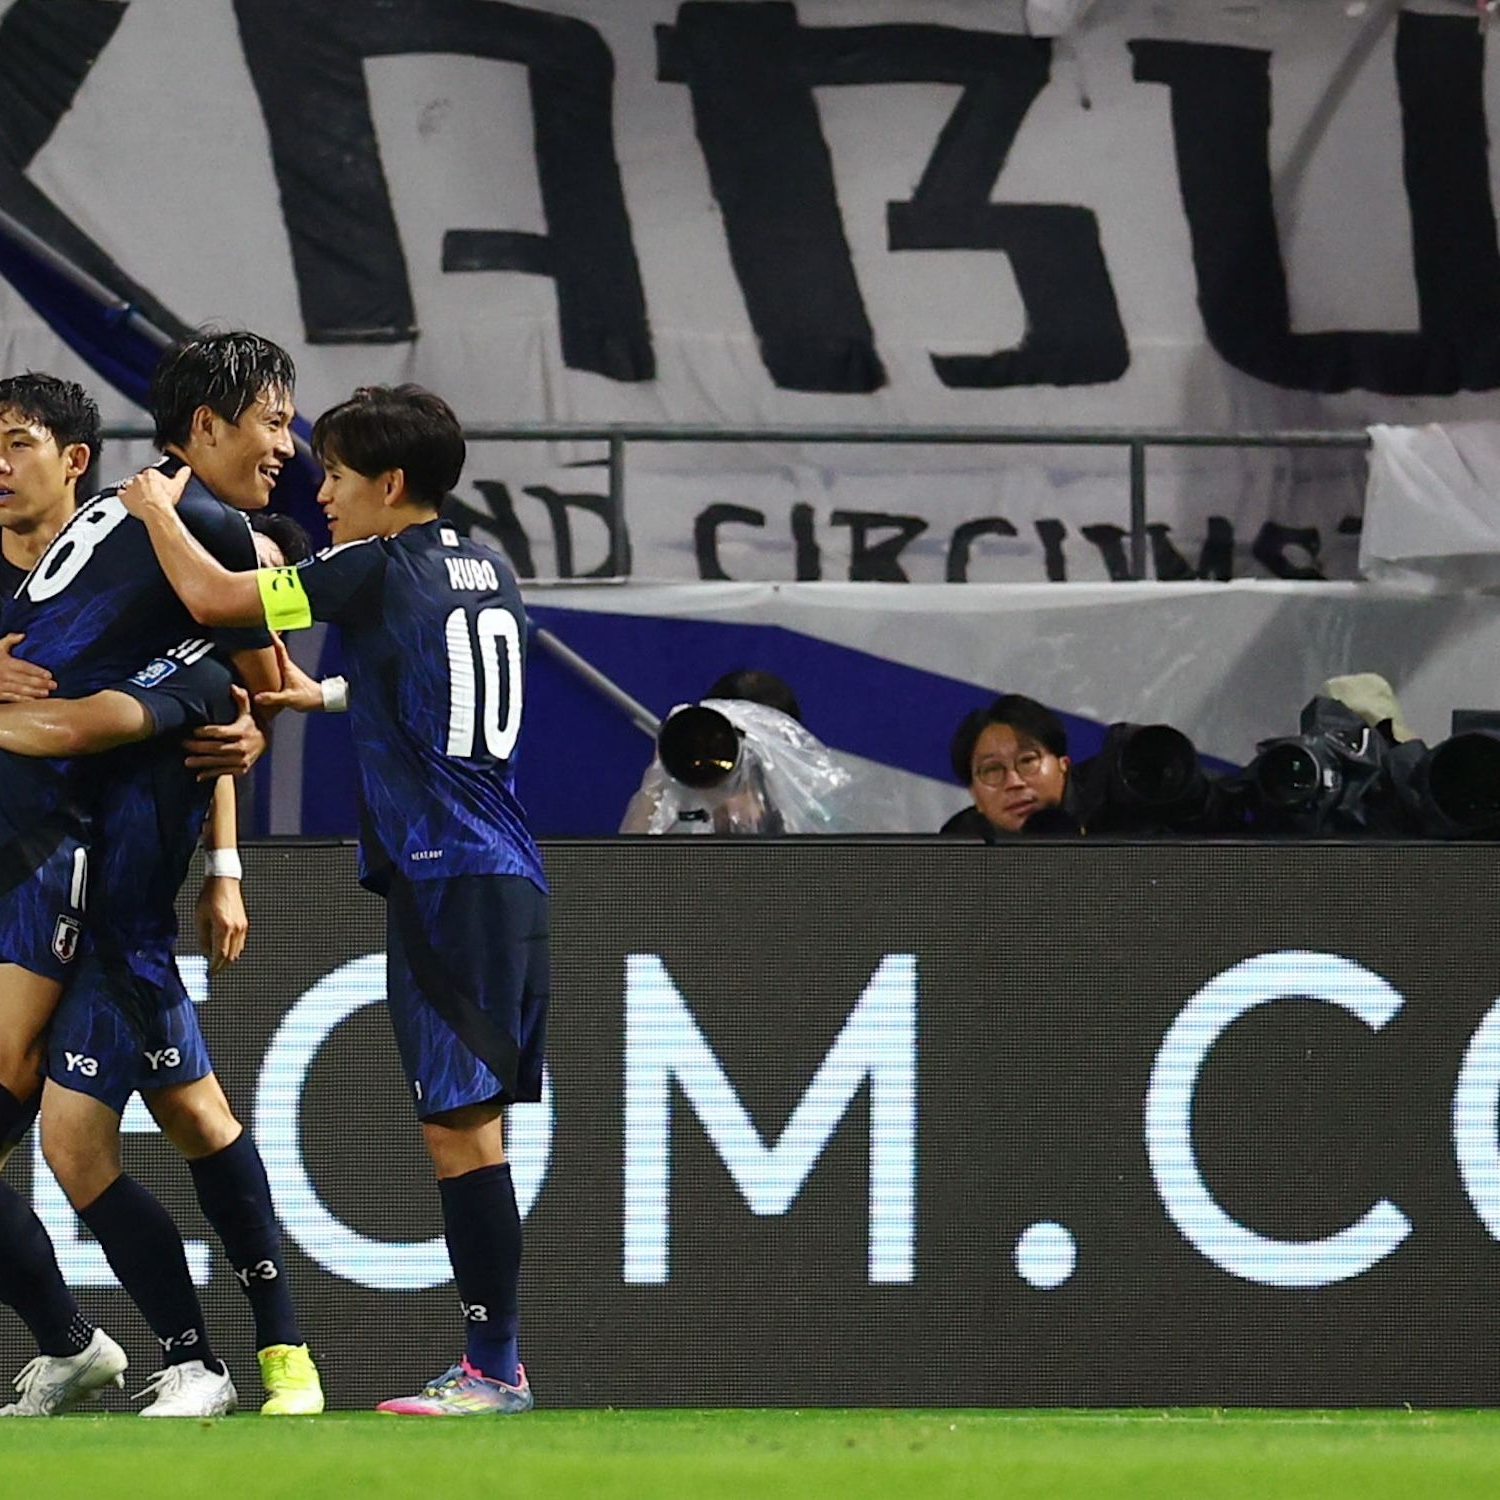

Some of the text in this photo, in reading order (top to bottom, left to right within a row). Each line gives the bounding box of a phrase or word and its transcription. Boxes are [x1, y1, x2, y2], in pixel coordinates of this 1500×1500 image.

[444, 557, 499, 592] KUBO
[445, 606, 523, 760] 10
[64, 1052, 98, 1077] Y-3
[145, 1047, 181, 1070] Y-3
[234, 1259, 278, 1287] Y-3
[157, 1328, 199, 1352] Y-3
